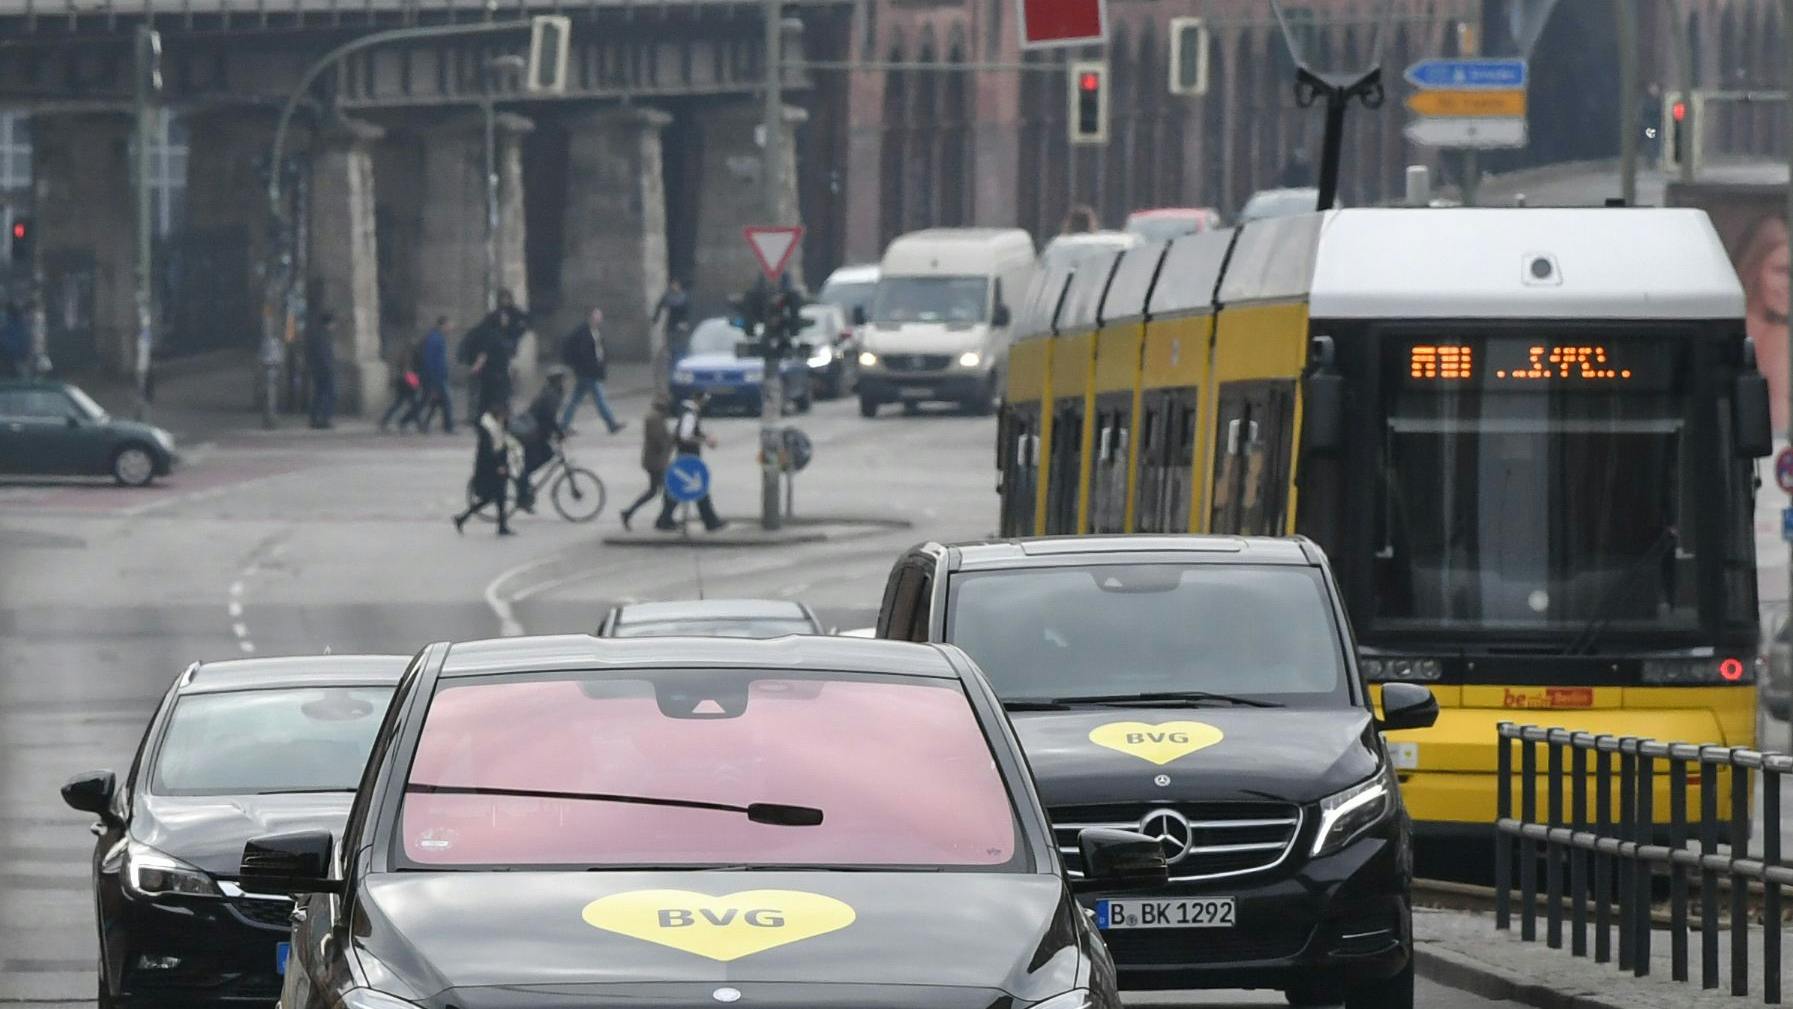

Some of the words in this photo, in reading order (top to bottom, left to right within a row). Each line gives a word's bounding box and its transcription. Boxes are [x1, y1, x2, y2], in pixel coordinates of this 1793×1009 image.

[1126, 732, 1189, 744] BVG
[657, 908, 785, 928] BVG
[1111, 903, 1125, 925] B
[1141, 903, 1171, 924] BK
[1176, 902, 1233, 924] 1292
